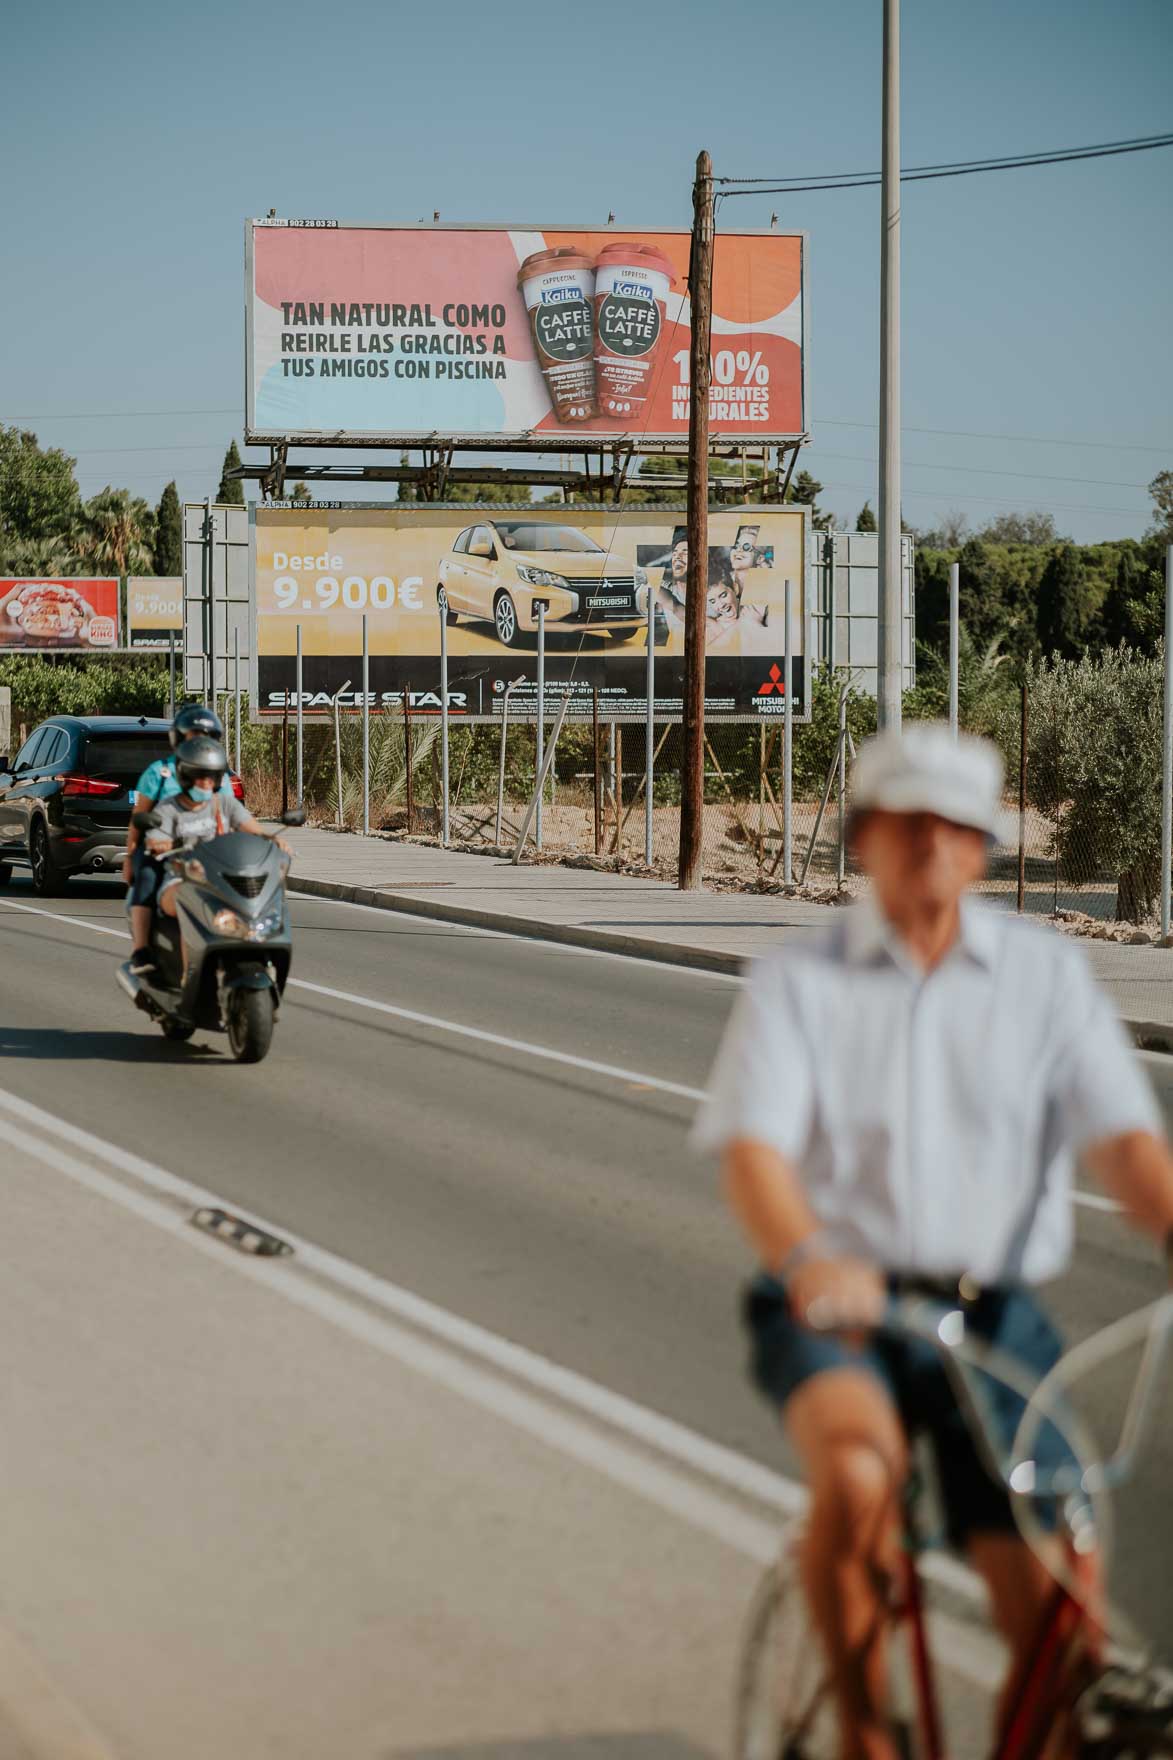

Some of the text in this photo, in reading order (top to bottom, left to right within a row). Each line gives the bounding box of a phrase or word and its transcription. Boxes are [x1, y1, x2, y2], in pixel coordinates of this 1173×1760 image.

[543, 289, 579, 304] Kaiku
[616, 281, 651, 298] Kaiku
[281, 302, 506, 328] TAN NATURAL COMO
[540, 306, 591, 329] CAFFÈ
[605, 305, 656, 325] CAFFÈ
[544, 324, 591, 343] LATTE
[605, 320, 653, 338] LATTE
[281, 333, 506, 355] REIRLE LAS GRACIAS A
[281, 359, 507, 380] TUS AMIGOS CON PISCINA
[672, 349, 769, 385] 10%
[671, 385, 769, 401] INEDIENTES
[671, 401, 769, 421] NURALES
[273, 552, 343, 571] Desde
[273, 576, 423, 609] 9.900€
[589, 597, 628, 606] MITSUBISHI
[268, 691, 467, 707] SPACE STAR
[752, 697, 799, 705] MITSUBIHI
